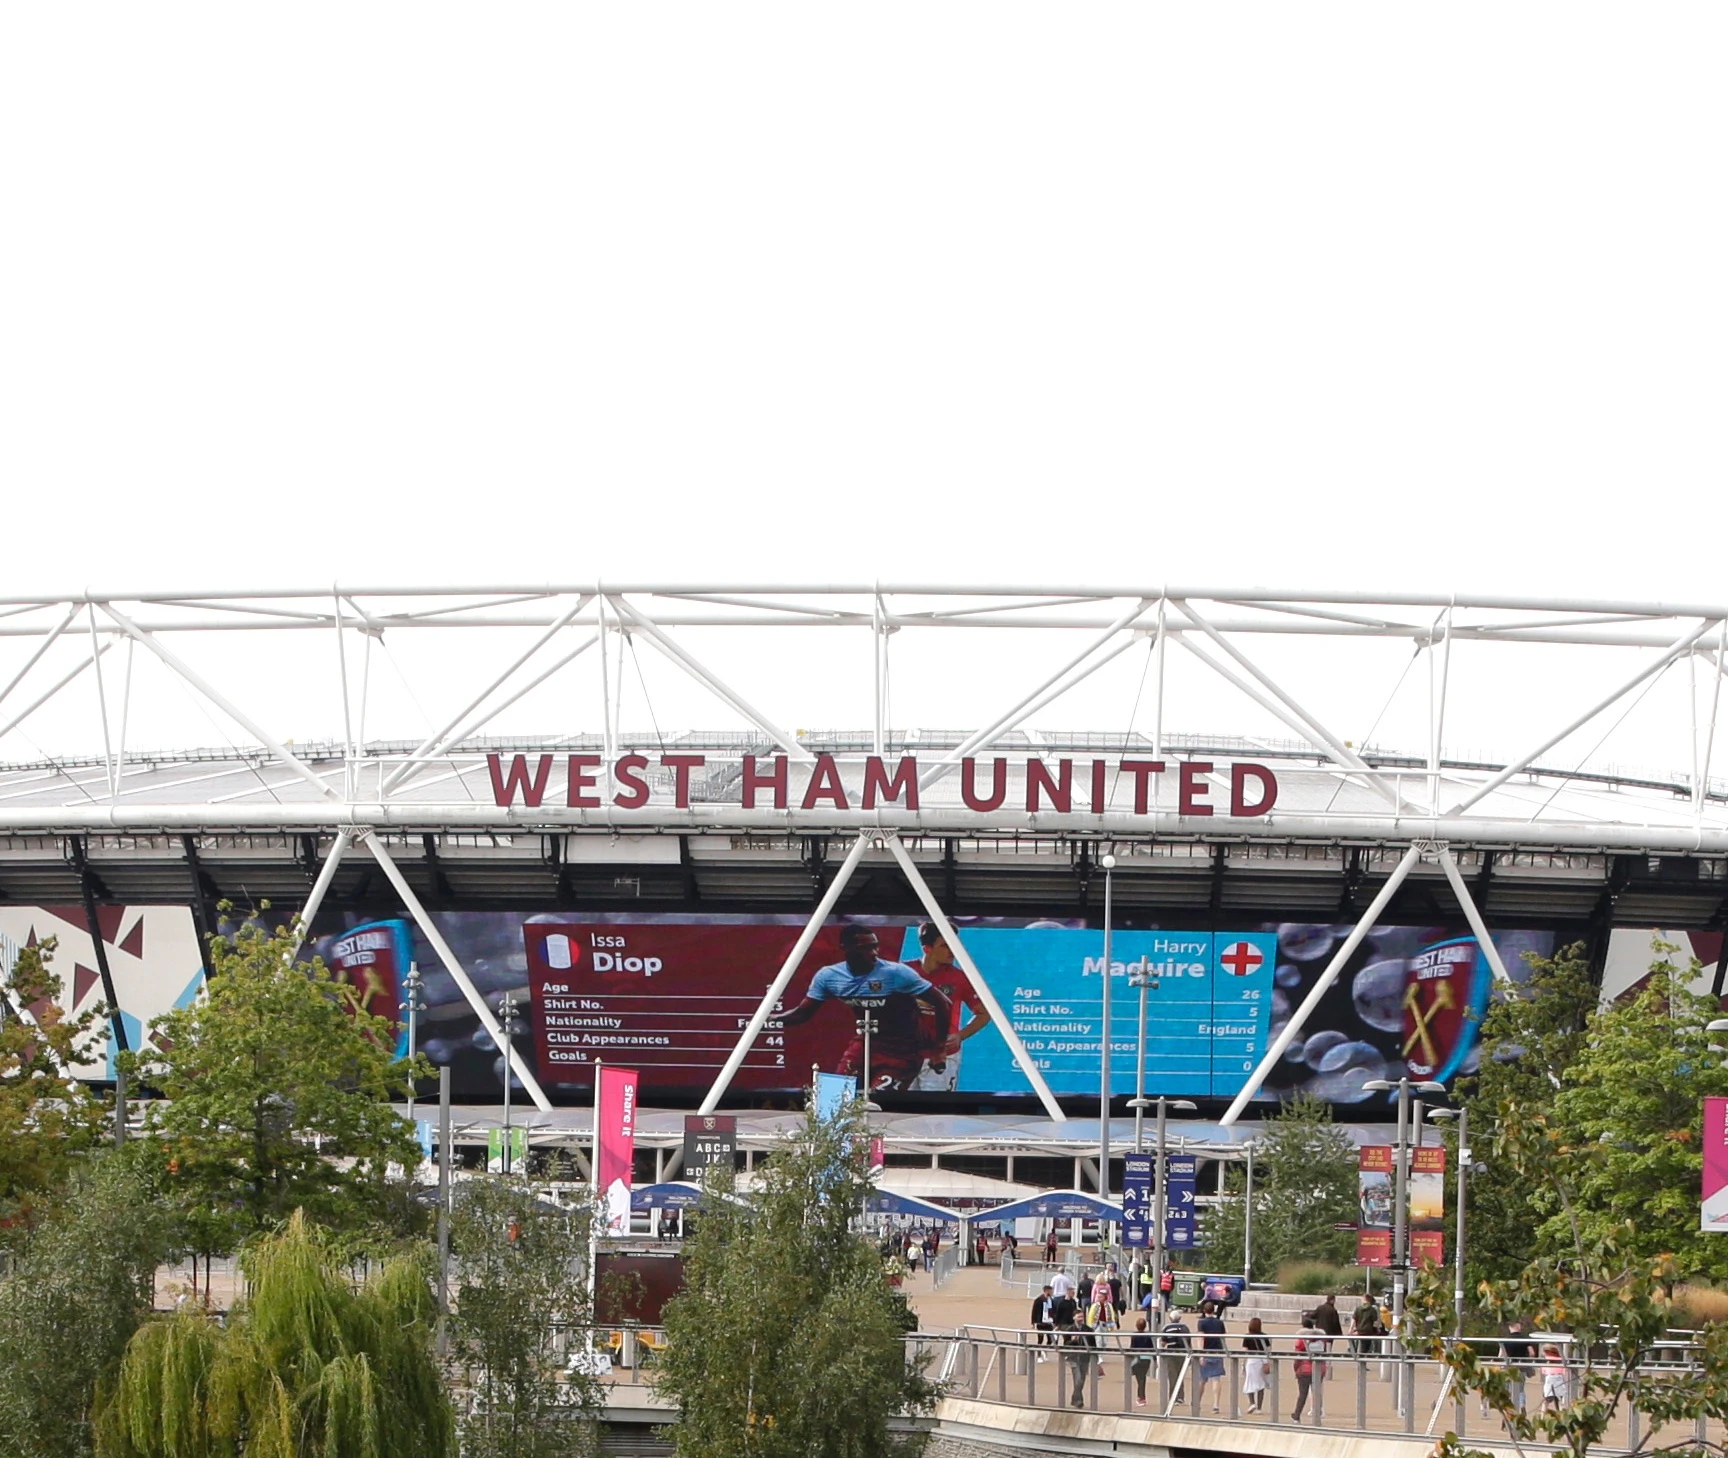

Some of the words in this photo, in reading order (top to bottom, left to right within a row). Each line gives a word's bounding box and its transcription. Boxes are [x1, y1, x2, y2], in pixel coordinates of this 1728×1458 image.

[486, 754, 706, 809] WEST
[742, 754, 919, 811] HAM
[961, 757, 1278, 817] UNITED
[591, 932, 625, 947] Issa
[1154, 940, 1206, 956] Harry
[592, 952, 663, 976] Diop
[542, 982, 569, 994] Age
[1014, 987, 1041, 998] Age
[1241, 989, 1260, 999] 26
[544, 999, 577, 1009] Shirt
[580, 1000, 604, 1010] No.
[1013, 1004, 1046, 1014] Shirt
[1049, 1005, 1073, 1015] No.
[1249, 1007, 1258, 1017] 5
[545, 1016, 622, 1028] Nationality
[737, 1018, 784, 1029] Frnce
[1013, 1022, 1092, 1034] Nationality
[1198, 1024, 1256, 1036] England
[547, 1033, 579, 1043] Club
[582, 1034, 670, 1046] Appearances
[766, 1036, 784, 1046] 44
[1021, 1039, 1045, 1050] lub
[1246, 1042, 1255, 1052] 5
[548, 1050, 587, 1061] Goals
[776, 1054, 784, 1064] 2
[1243, 1062, 1252, 1071] 0
[623, 1084, 634, 1123] Share
